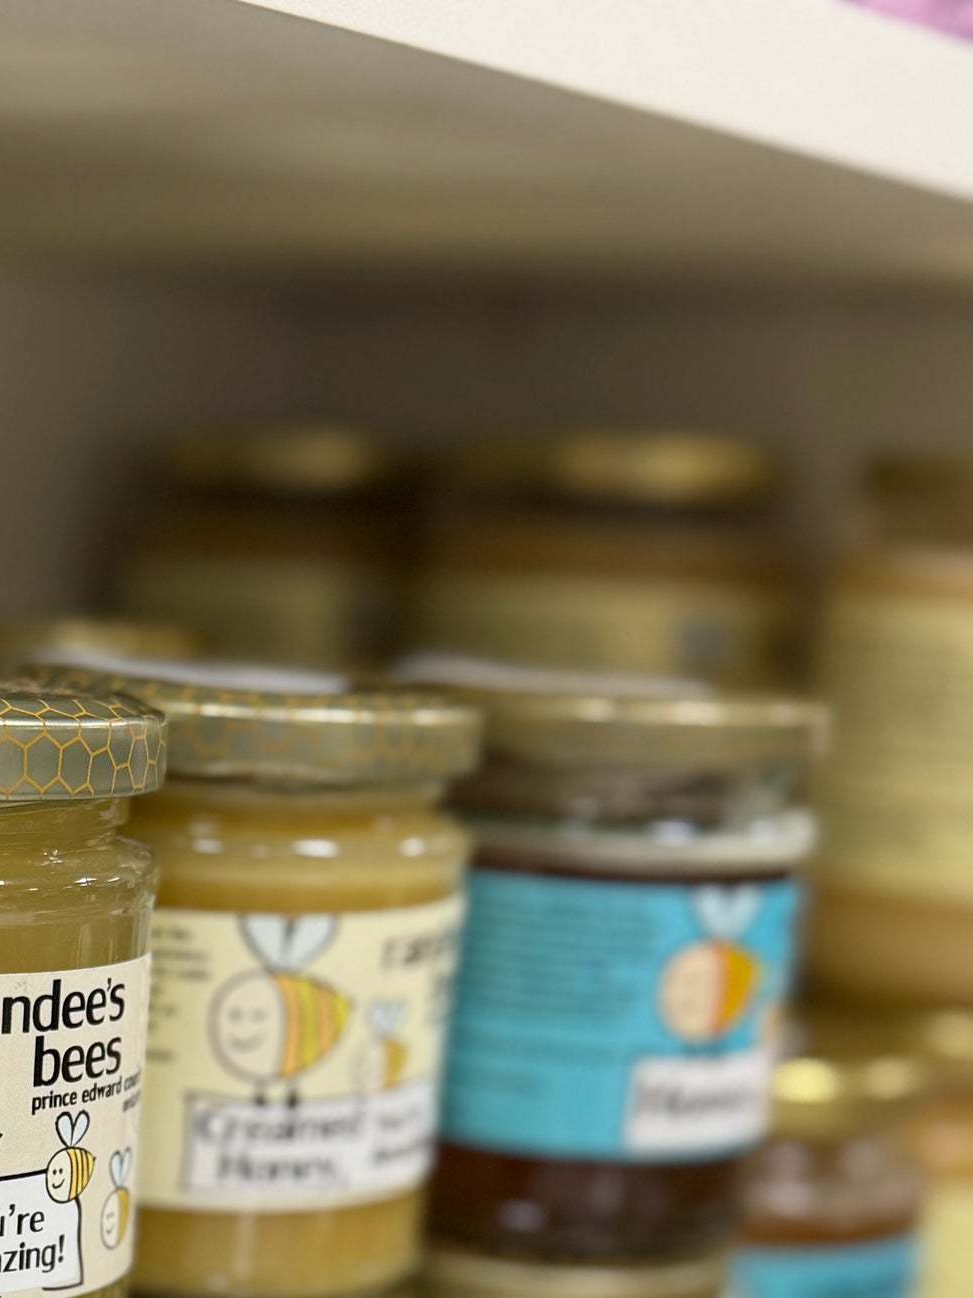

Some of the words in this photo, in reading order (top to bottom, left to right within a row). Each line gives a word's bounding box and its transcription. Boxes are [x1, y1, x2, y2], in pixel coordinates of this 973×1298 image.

[32, 1036, 122, 1087] bees
[31, 1089, 77, 1115] prince
[81, 1075, 123, 1104] edward
